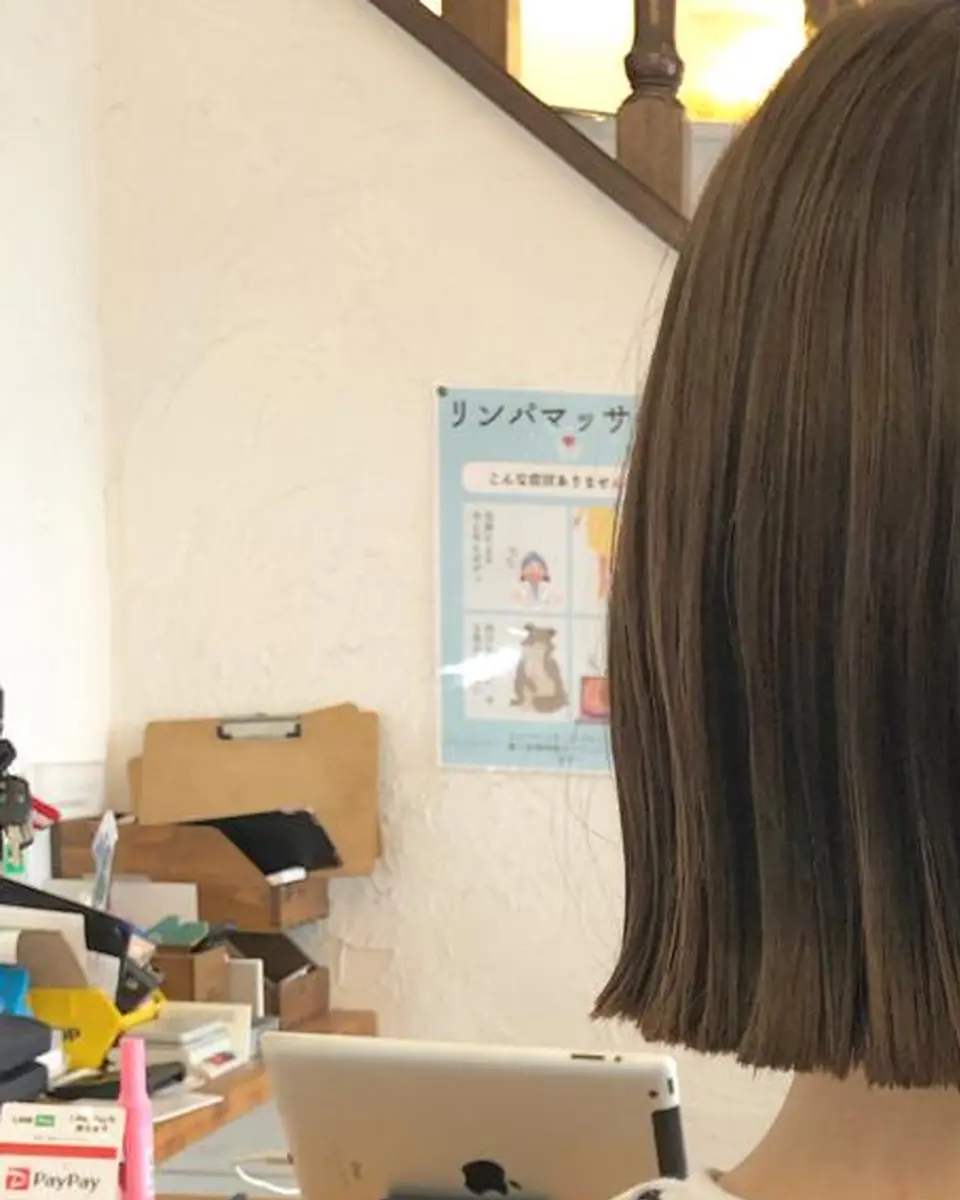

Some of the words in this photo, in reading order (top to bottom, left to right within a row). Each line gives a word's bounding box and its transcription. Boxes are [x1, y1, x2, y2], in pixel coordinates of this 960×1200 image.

[450, 400, 630, 434] リンパマッサ
[33, 1172, 100, 1193] PayPay
